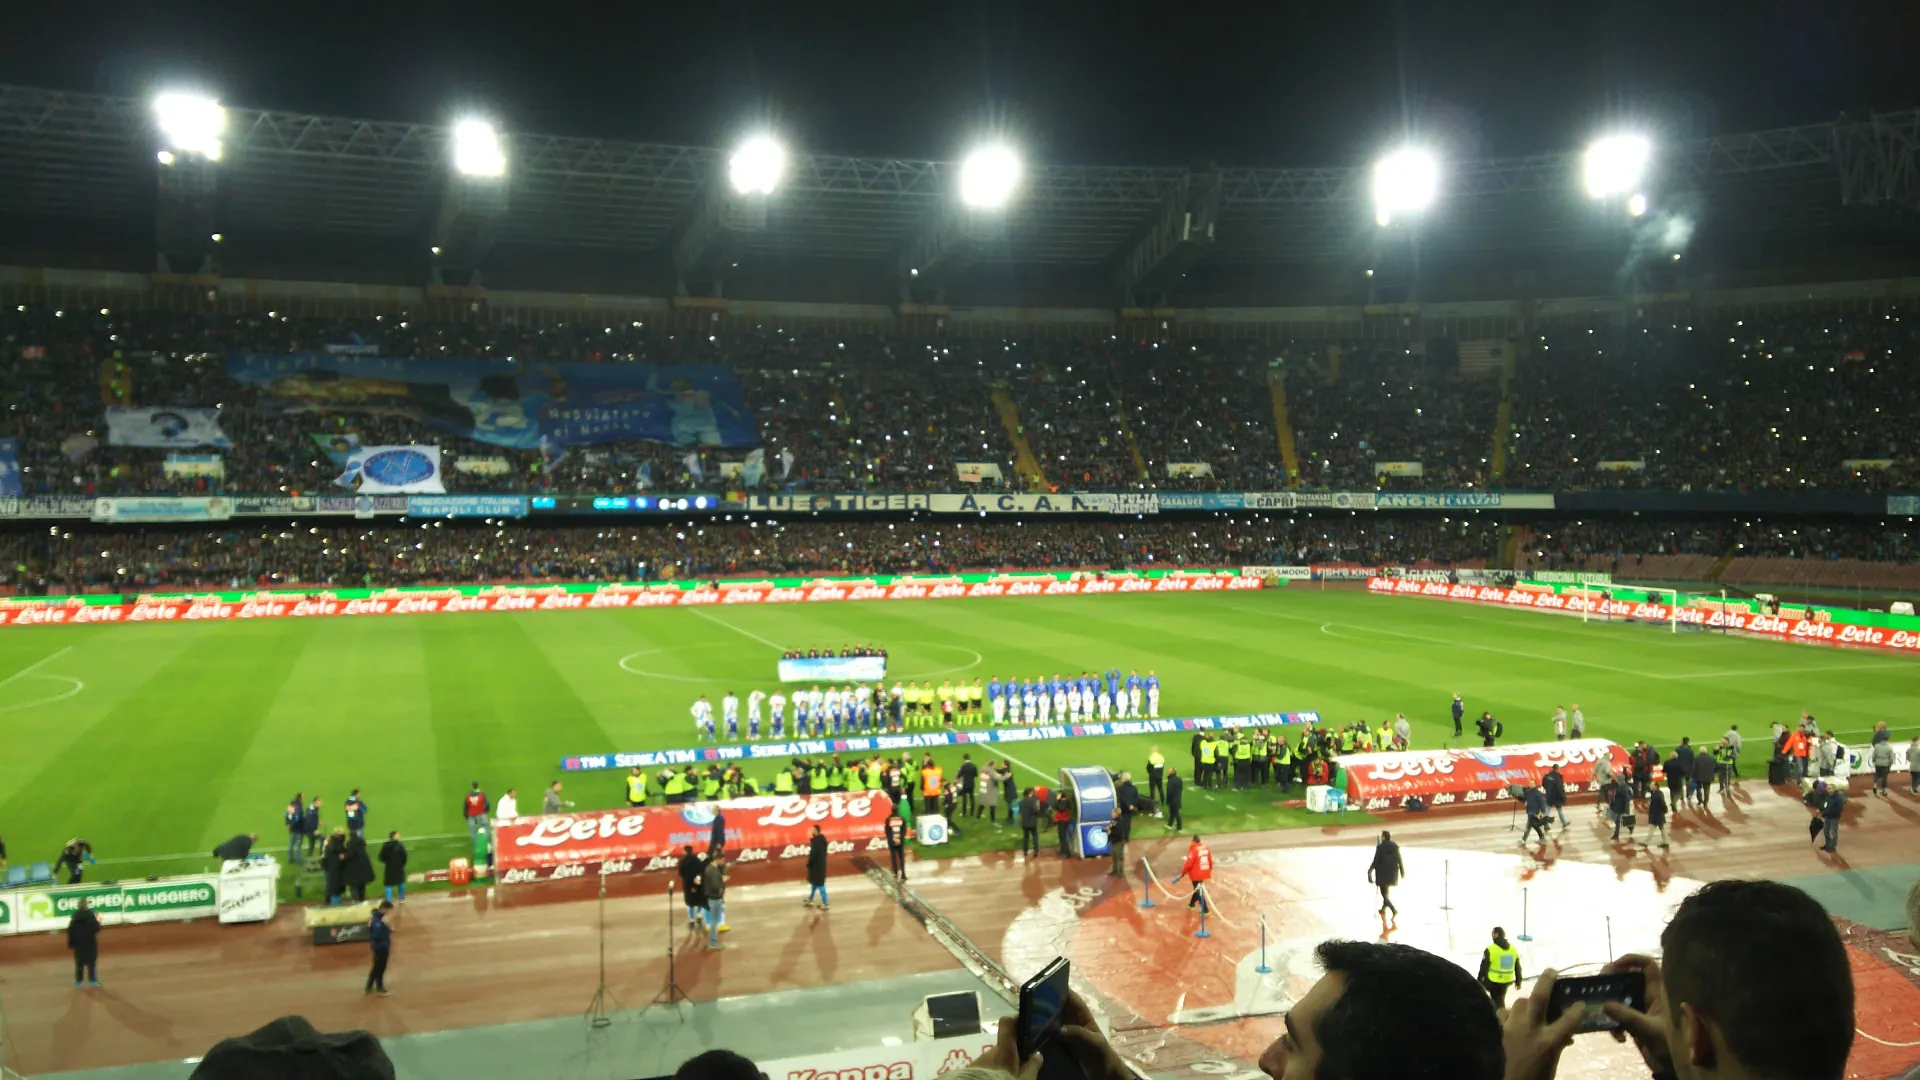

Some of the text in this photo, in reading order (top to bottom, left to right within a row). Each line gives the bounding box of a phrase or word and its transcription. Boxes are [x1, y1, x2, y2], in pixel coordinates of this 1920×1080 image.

[422, 506, 470, 515] NAPOLI
[744, 494, 928, 511] LUE TIGER
[1257, 497, 1294, 508] CAPRI
[1565, 594, 1596, 611] Lete
[1597, 597, 1630, 614] Lete
[1632, 599, 1666, 618] Lete
[1668, 604, 1704, 623] Lete
[1705, 610, 1745, 628] Lete
[1746, 615, 1788, 633] Lete
[1790, 619, 1834, 638] Lete
[1836, 625, 1883, 643] Lete
[1368, 755, 1455, 780] Lete
[1432, 792, 1455, 805] Lete
[1464, 790, 1487, 802] Lete
[757, 793, 872, 826] Lete
[516, 813, 645, 847] Lete
[644, 855, 679, 871] Lete
[736, 848, 769, 862] Lete
[550, 864, 585, 880] Lete
[598, 859, 632, 875] Lete
[500, 868, 537, 884] Lete
[138, 888, 210, 906] RUGGIERO
